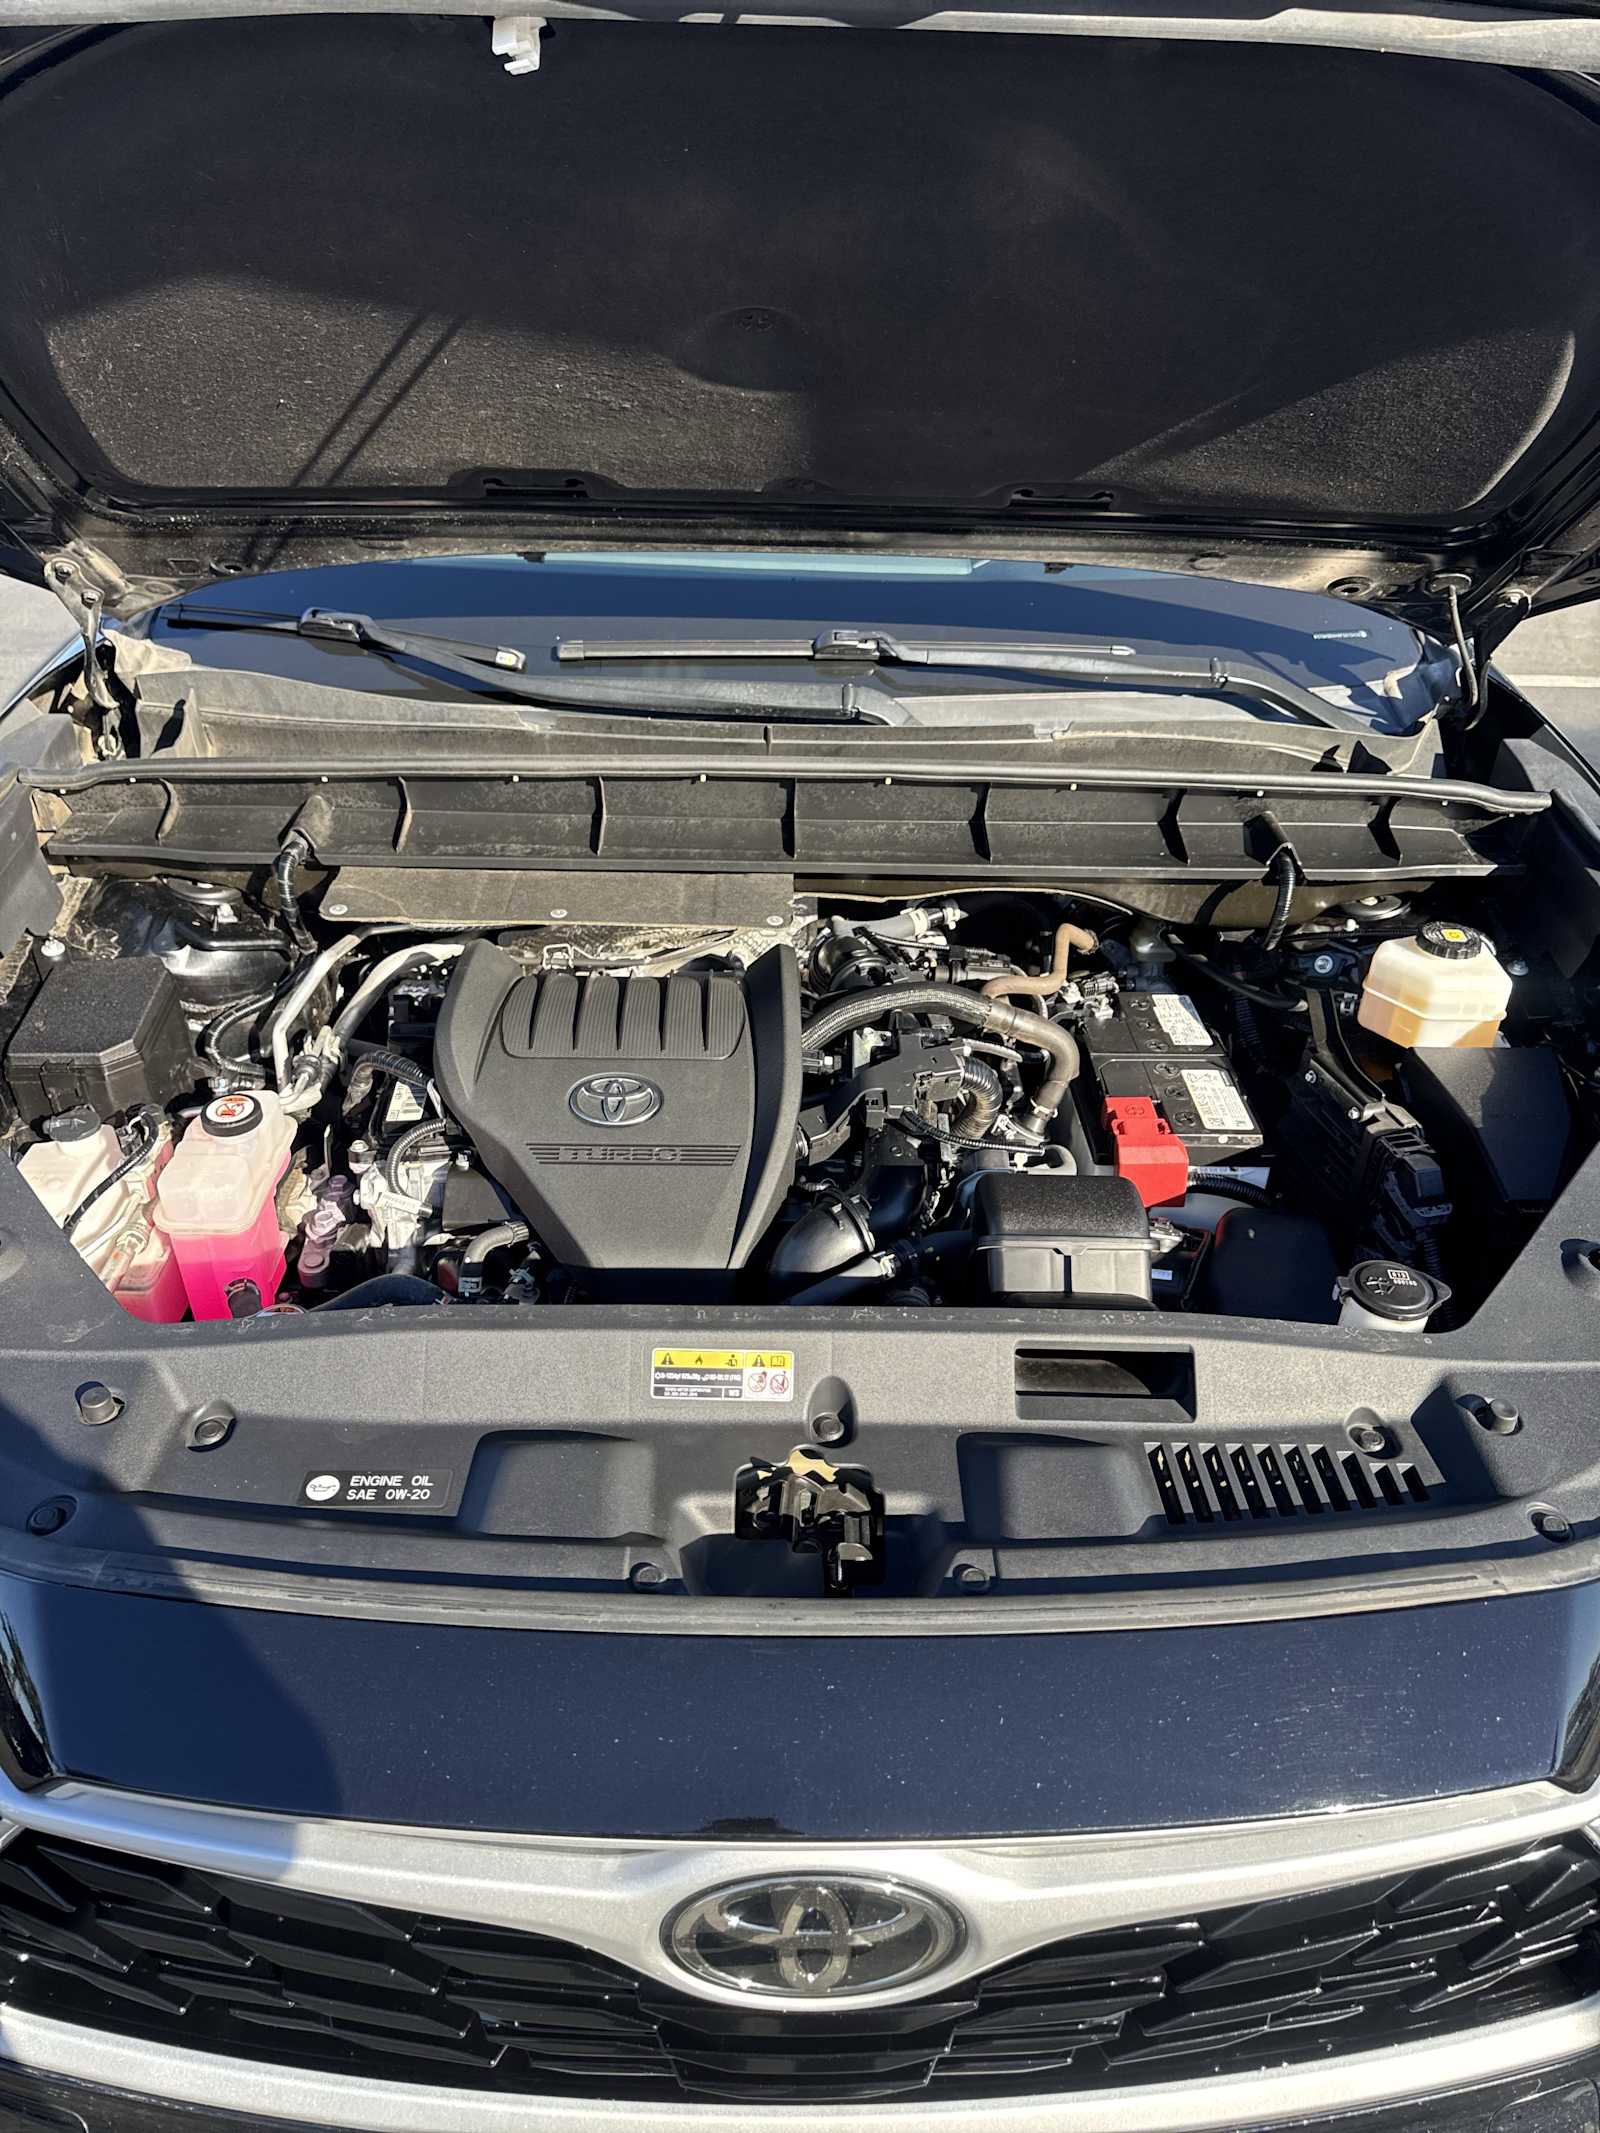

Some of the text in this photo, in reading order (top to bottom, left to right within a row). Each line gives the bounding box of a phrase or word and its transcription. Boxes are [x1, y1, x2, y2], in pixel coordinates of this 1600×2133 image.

[560, 1146, 678, 1162] TURBO
[349, 1475, 434, 1487] ENGINE OIL
[346, 1488, 431, 1501] SAE 0W-20
